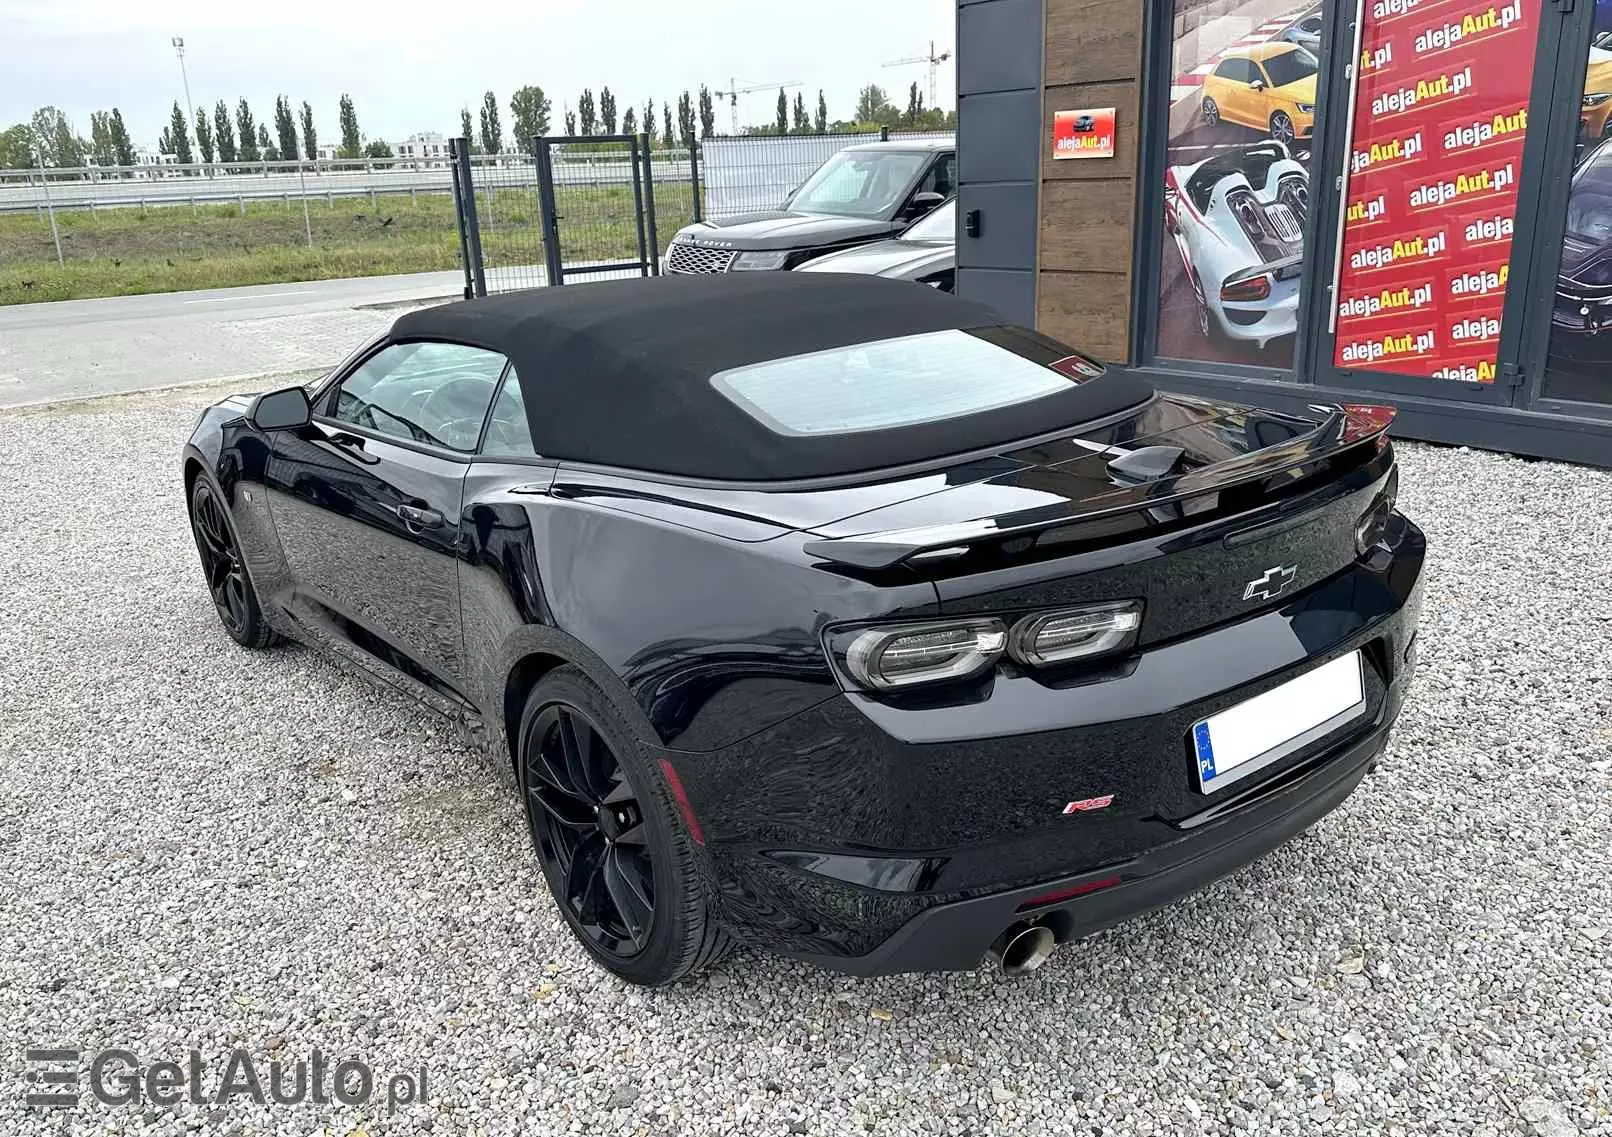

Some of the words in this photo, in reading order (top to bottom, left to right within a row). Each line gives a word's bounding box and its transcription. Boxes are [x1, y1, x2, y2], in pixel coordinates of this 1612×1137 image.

[1415, 0, 1521, 53] alejaAut.pl
[1372, 67, 1471, 116] alejaAut.pl
[1057, 134, 1111, 151] alejaAut.pl
[1351, 132, 1422, 173] jaAut.pl
[1409, 163, 1513, 206] alejaAut.pl
[1465, 215, 1513, 241] aleja
[1350, 232, 1446, 269] alejaAut.pl
[1339, 284, 1432, 318] alejaAut.pl
[1452, 316, 1500, 340] aleja
[1342, 331, 1434, 362] alejaAut.pl
[1201, 758, 1214, 774] PL
[1062, 794, 1114, 814] RS
